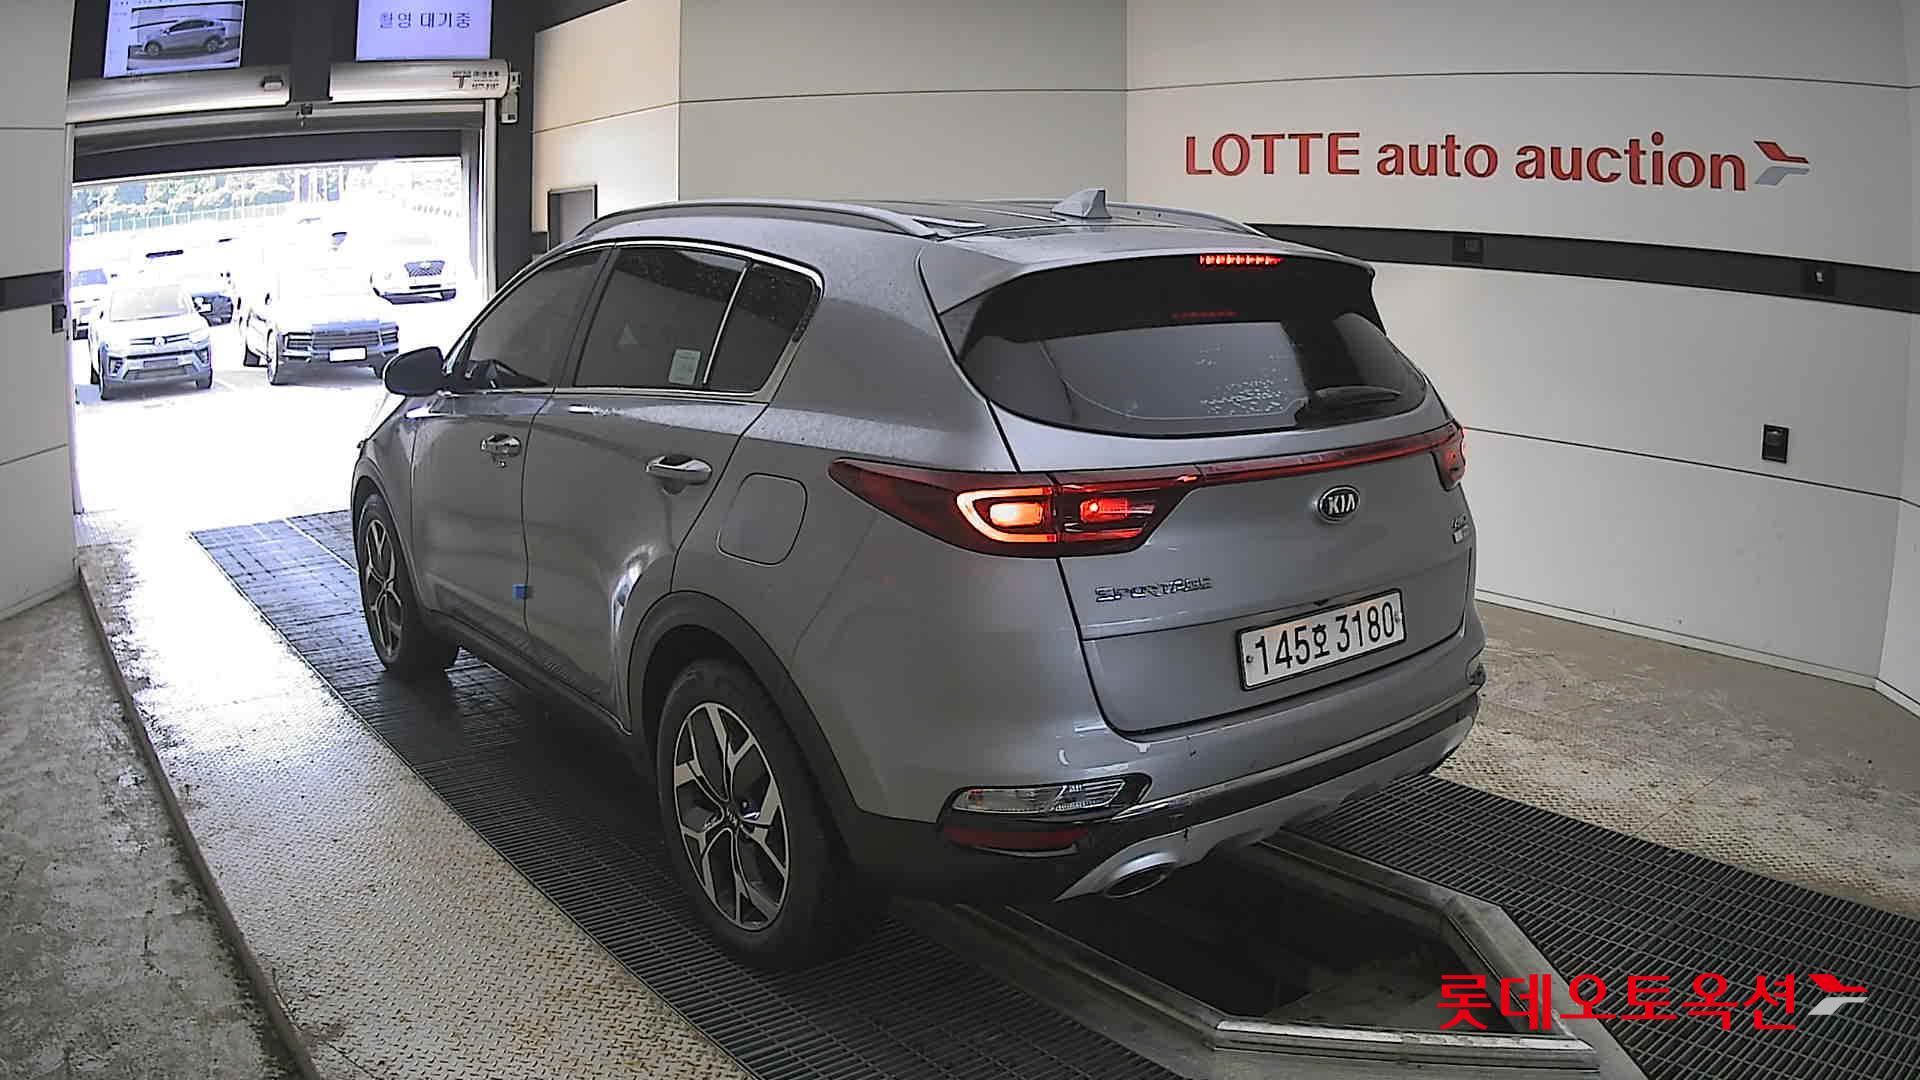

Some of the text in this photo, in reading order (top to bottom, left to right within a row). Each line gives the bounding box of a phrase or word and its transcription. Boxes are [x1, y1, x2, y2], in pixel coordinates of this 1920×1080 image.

[420, 12, 472, 29] 대기중
[1185, 131, 1746, 191] LOTTE auto auction
[1327, 494, 1356, 515] KIA
[1255, 602, 1395, 675] 145호 3180
